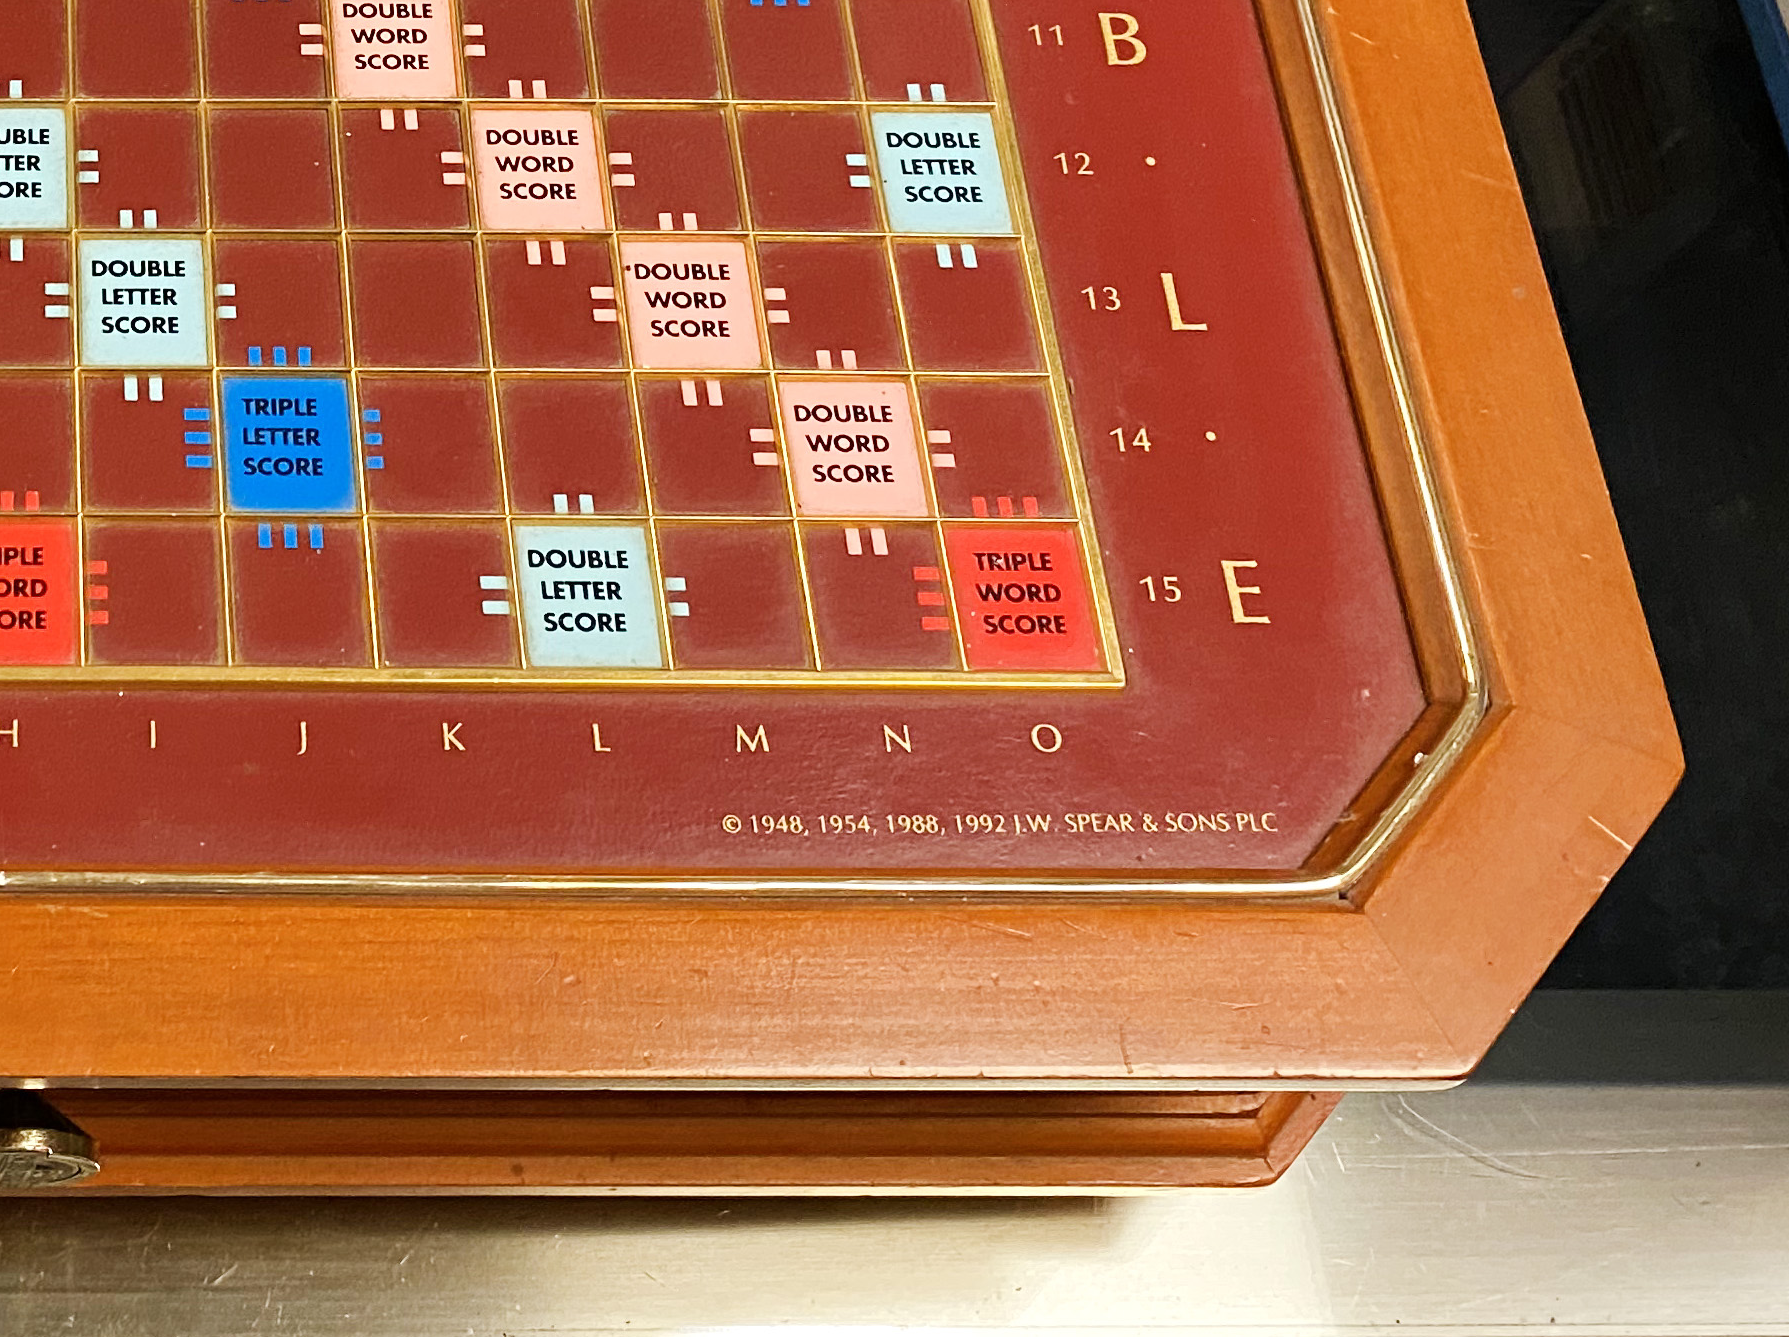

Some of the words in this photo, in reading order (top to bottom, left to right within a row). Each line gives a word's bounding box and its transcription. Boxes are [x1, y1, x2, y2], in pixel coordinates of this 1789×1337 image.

[1026, 23, 1065, 47] 11
[485, 128, 580, 147] DOUBLE
[493, 154, 575, 174] WORD
[1052, 151, 1095, 176] 12
[498, 181, 578, 201] SCORE
[634, 262, 732, 282] DOUBLE
[643, 290, 728, 310] WORD
[1080, 285, 1122, 312] 13
[649, 318, 731, 339] SCORE
[242, 397, 318, 418] TRIPLE
[242, 426, 322, 448] LETTER
[1108, 426, 1153, 453] 14
[242, 456, 324, 478] SCORE
[526, 548, 630, 570] DOUBLE
[539, 579, 624, 602] LETTER
[1138, 574, 1183, 604] 15
[542, 611, 628, 634] SCORE
[296, 719, 309, 756] J
[441, 721, 467, 752] K
[591, 721, 613, 753] L
[735, 723, 771, 754] M
[882, 723, 913, 754] N
[1030, 722, 1064, 754] O
[750, 813, 809, 837] 1948,
[817, 813, 878, 838] 1954,
[884, 813, 947, 838] 1988,
[954, 813, 1007, 835] 1992
[1063, 811, 1135, 835] SPEAR
[1141, 812, 1159, 833] &
[1164, 811, 1232, 835] SONS
[1234, 811, 1279, 833] PLC
